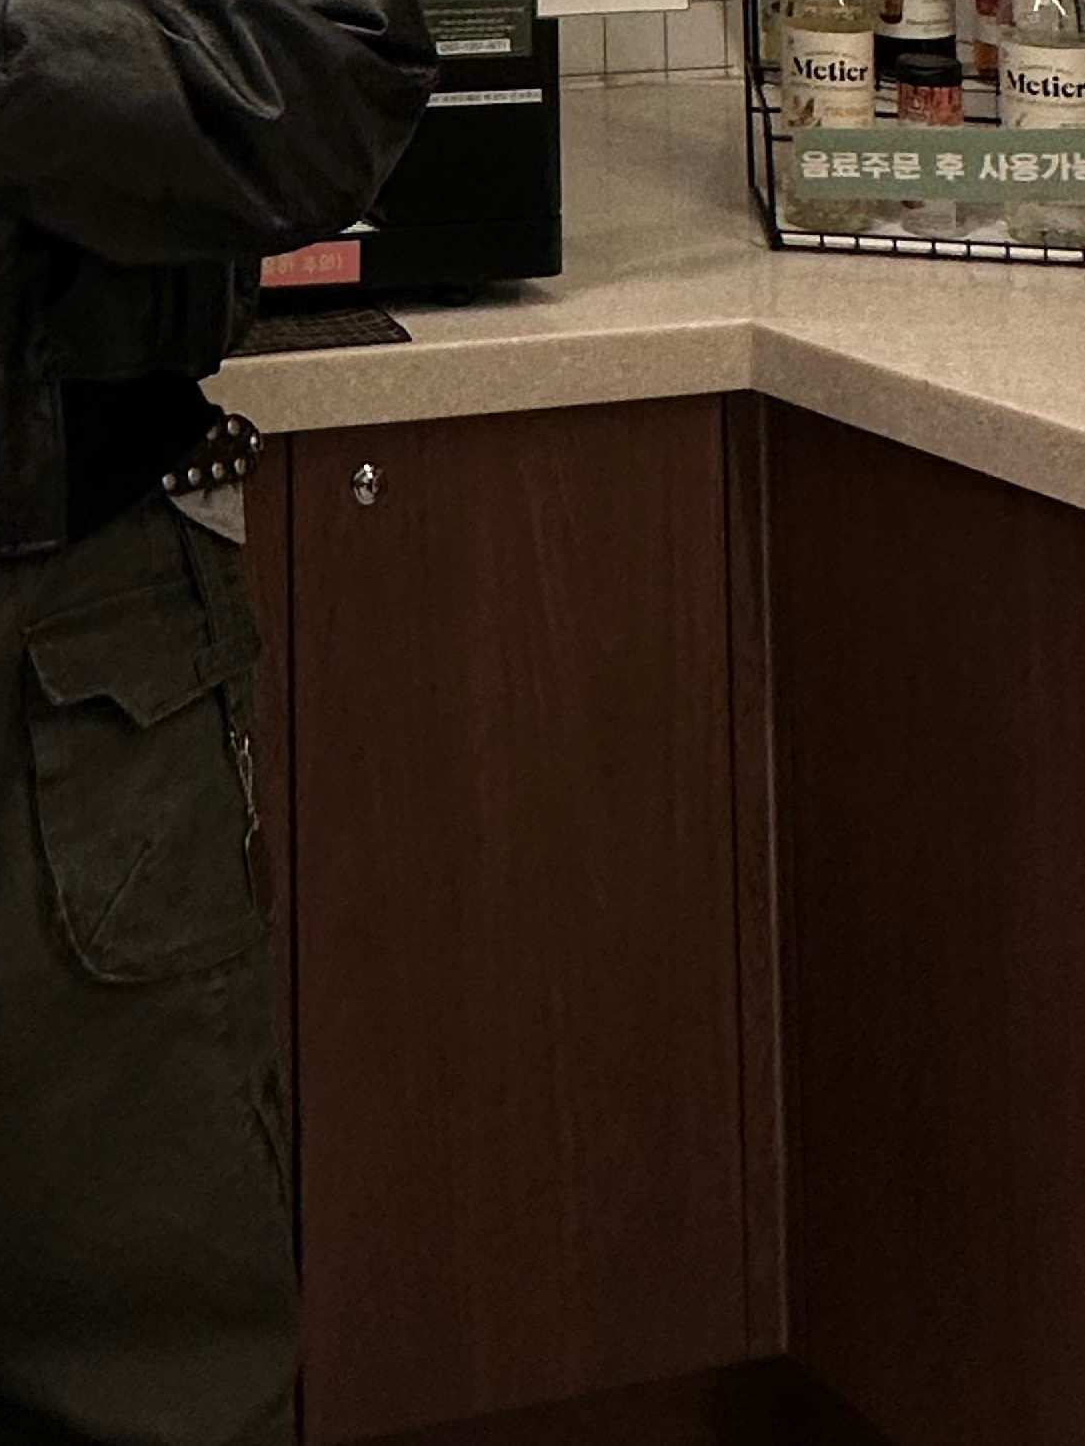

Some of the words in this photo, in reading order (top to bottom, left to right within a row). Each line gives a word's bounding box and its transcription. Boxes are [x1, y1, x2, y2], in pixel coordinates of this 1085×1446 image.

[794, 56, 869, 82] Metier
[800, 150, 922, 180] 음료주문
[935, 152, 965, 181] 후
